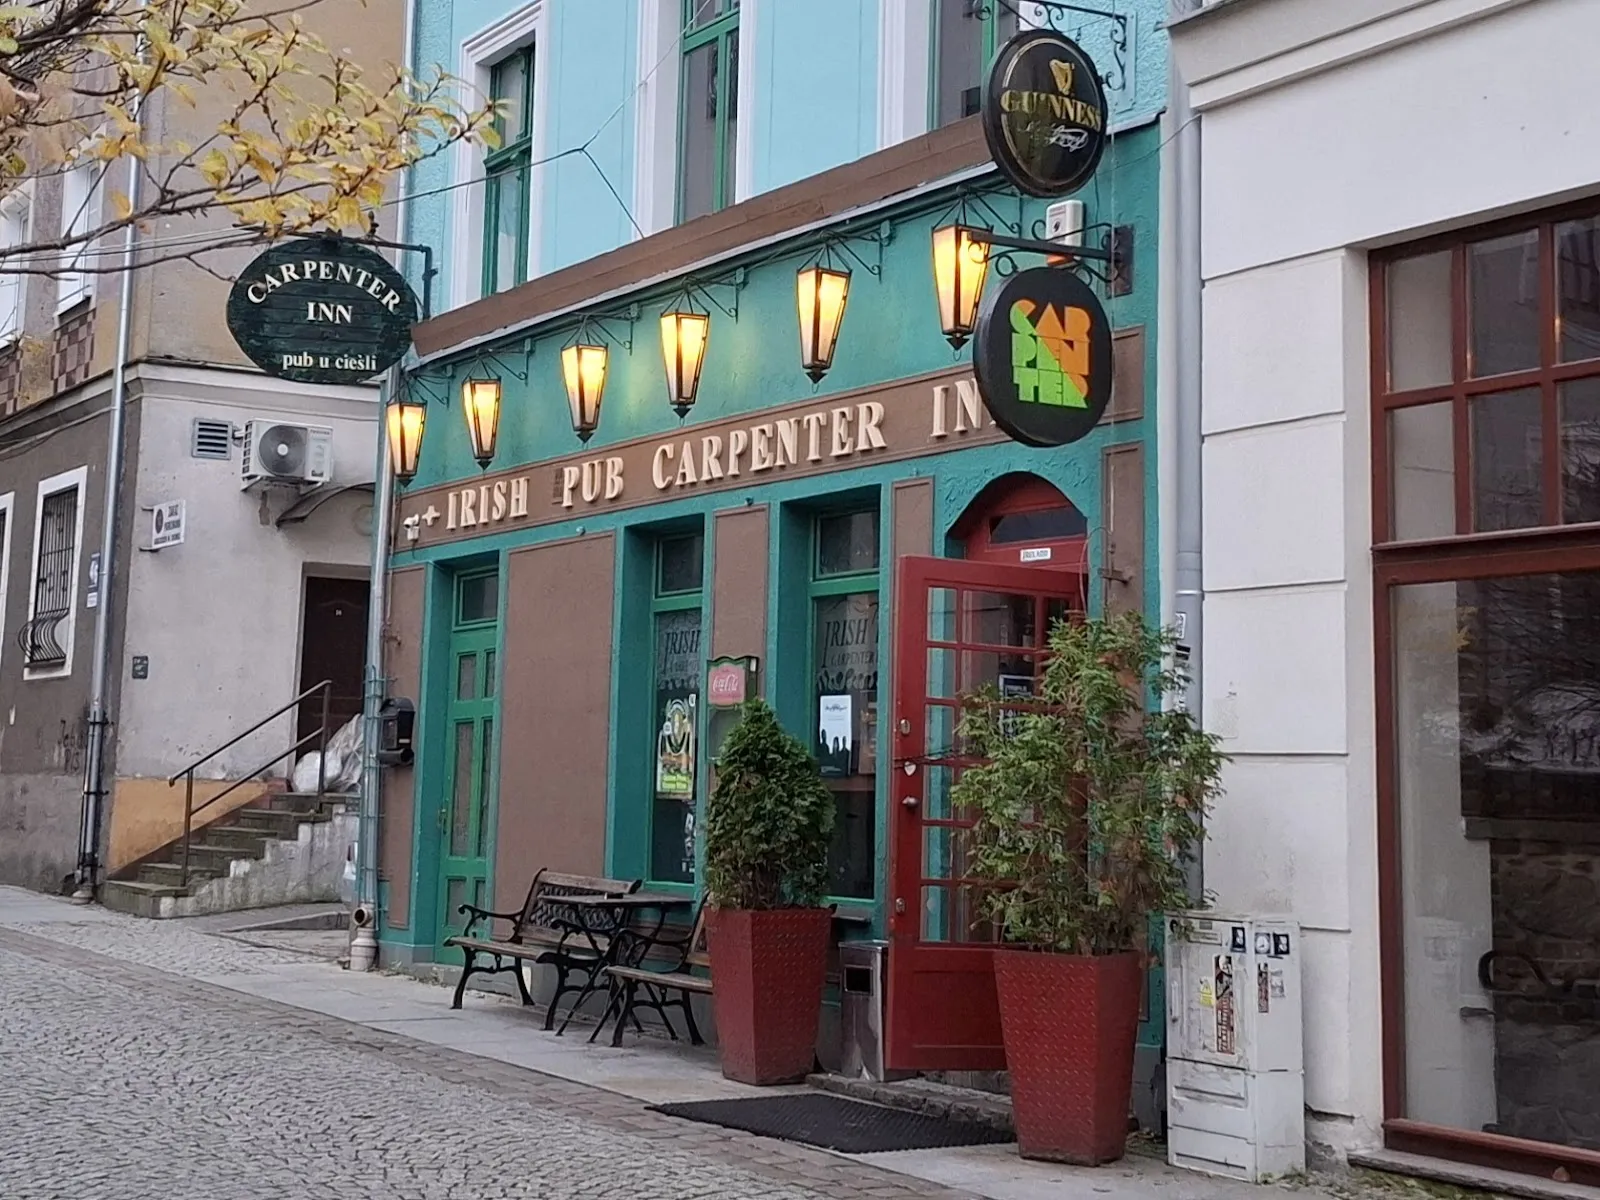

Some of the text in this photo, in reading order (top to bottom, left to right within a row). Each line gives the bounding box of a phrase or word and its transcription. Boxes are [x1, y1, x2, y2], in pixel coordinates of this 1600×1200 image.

[247, 260, 401, 315] CARPENTER
[306, 301, 353, 324] INN
[1009, 299, 1091, 340] CAR
[282, 351, 314, 371] pub
[319, 357, 330, 369] u
[1012, 333, 1090, 375] PEN
[1014, 367, 1089, 408] TER
[446, 377, 997, 530] IRISH PUB CARPENTER IN
[822, 618, 870, 669] IRISH
